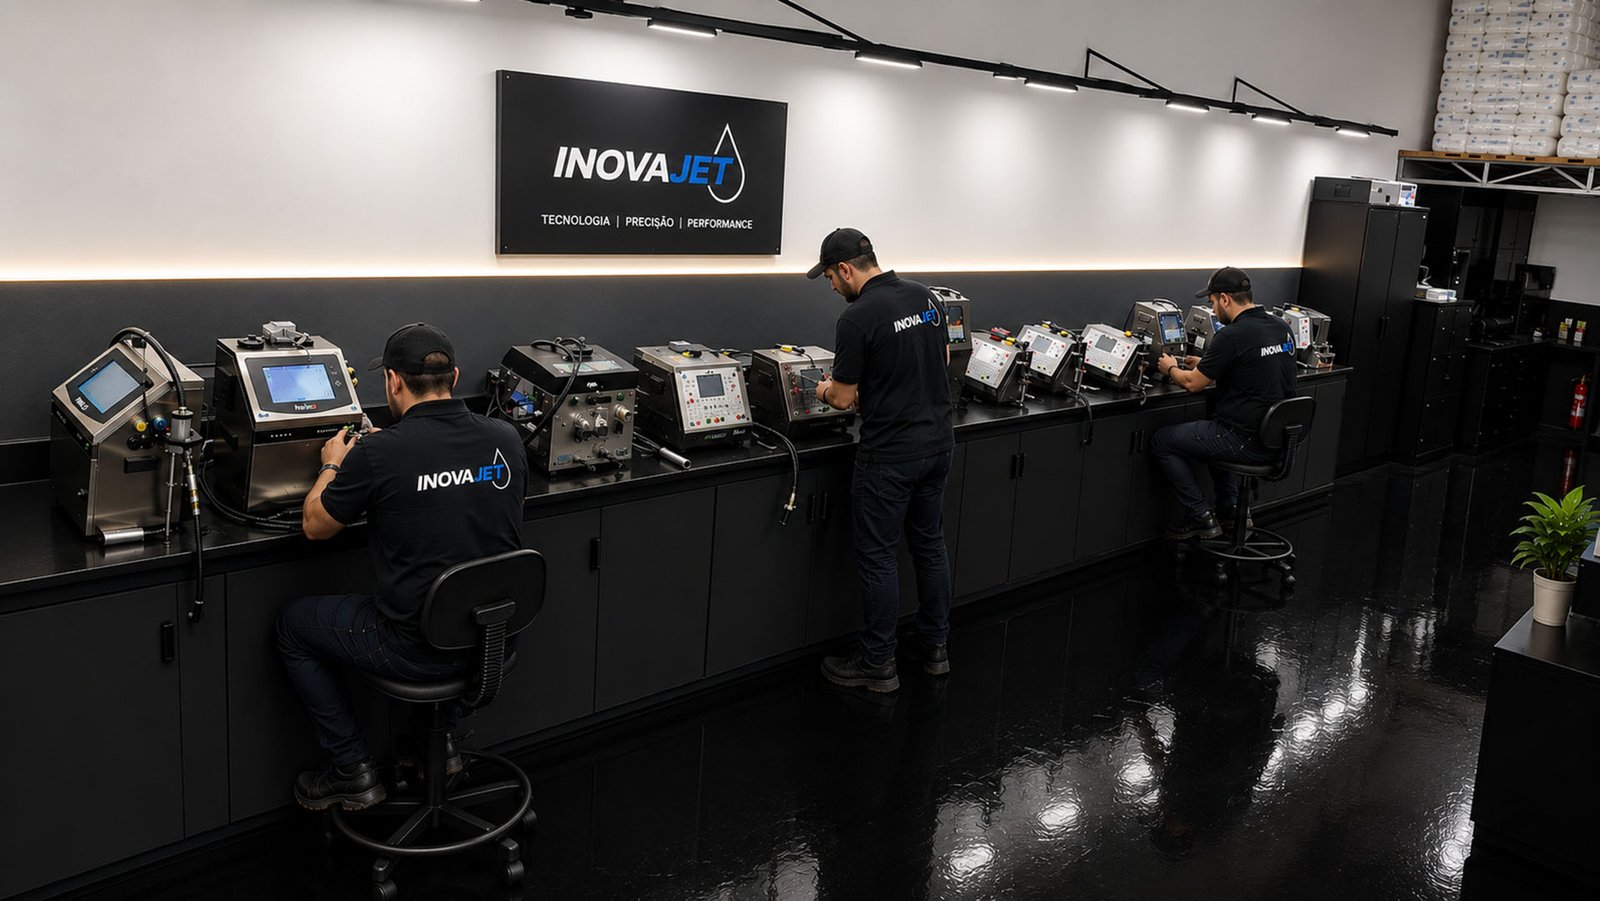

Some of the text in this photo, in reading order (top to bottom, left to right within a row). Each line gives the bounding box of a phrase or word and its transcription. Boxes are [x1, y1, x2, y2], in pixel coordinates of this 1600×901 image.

[553, 146, 734, 185] INOVAJET
[541, 214, 611, 227] TECNOLOGIA
[687, 218, 753, 230] PERFORMANCE
[894, 309, 936, 332] INOVAJET
[417, 463, 505, 492] INOVAJET
